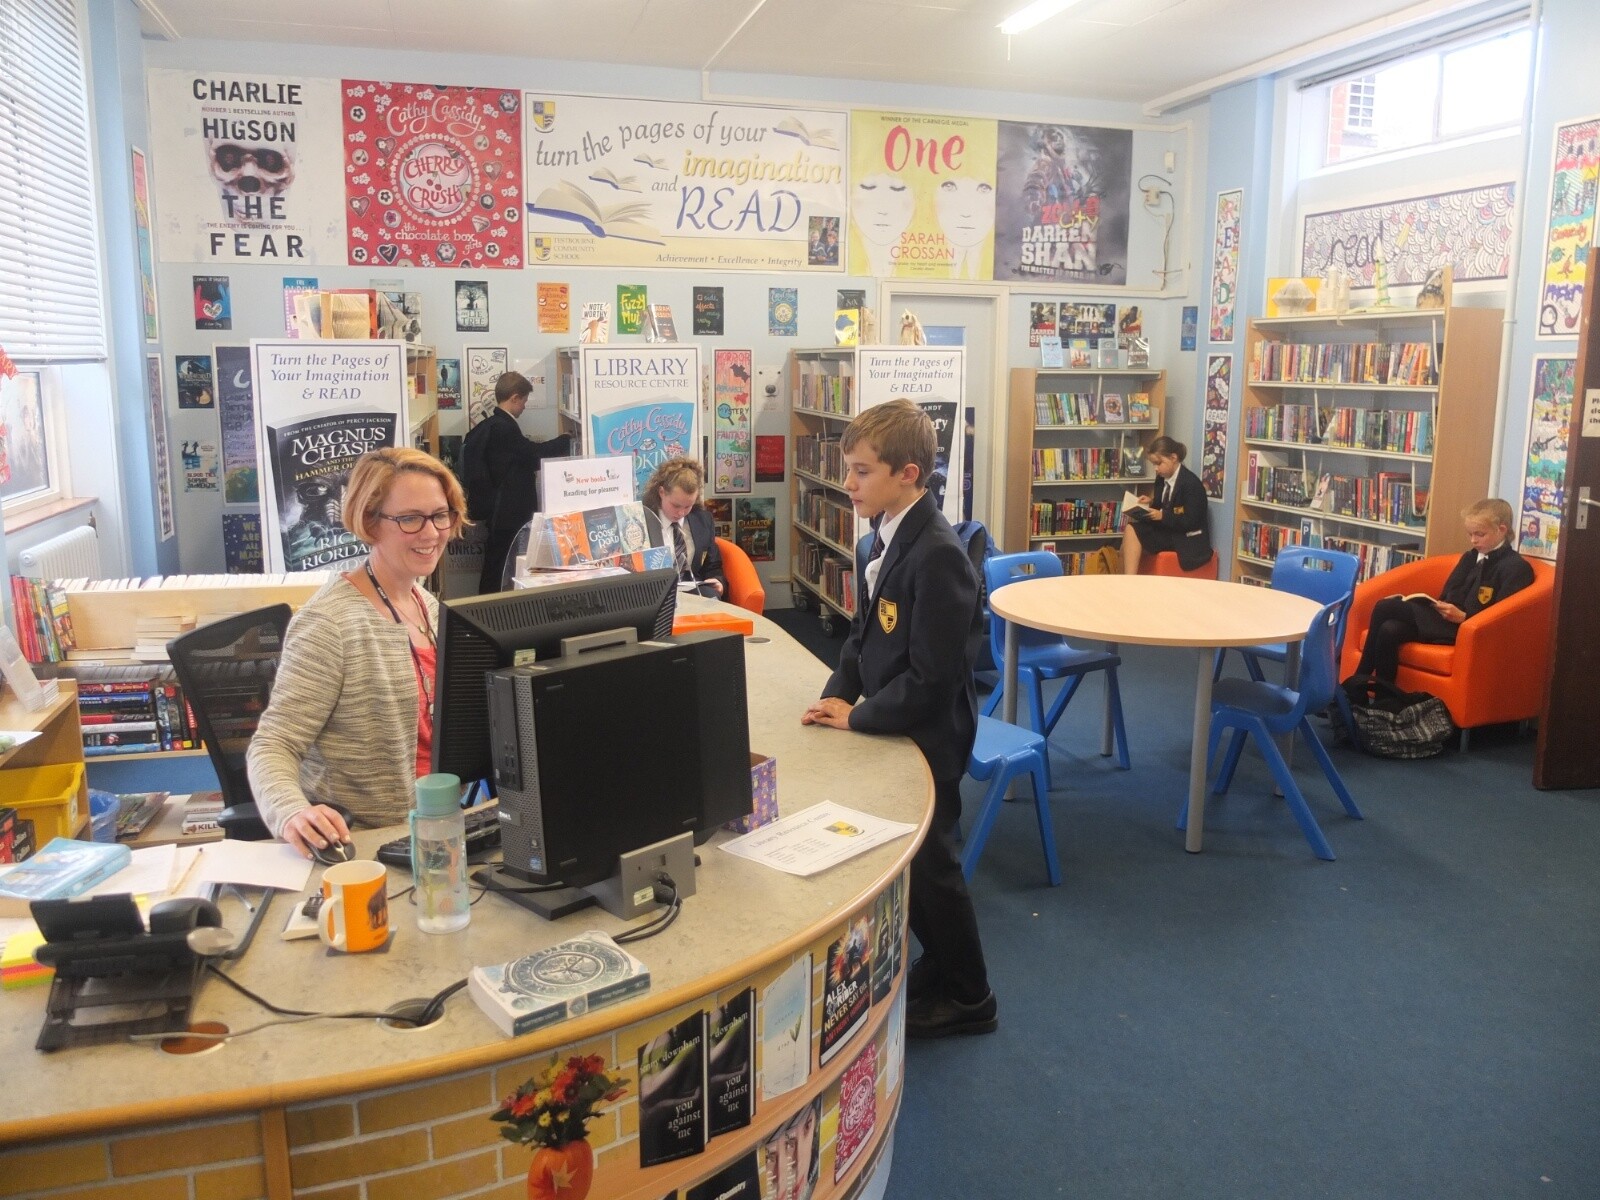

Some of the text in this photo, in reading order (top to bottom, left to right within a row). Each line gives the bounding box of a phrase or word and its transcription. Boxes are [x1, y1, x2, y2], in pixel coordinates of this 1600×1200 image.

[192, 78, 303, 105] CHARLIE
[386, 95, 487, 137] Cathy Cassidy
[922, 118, 951, 126] CARNEGIE
[202, 118, 296, 143] HIGSON
[536, 111, 767, 167] turn the pages of your
[884, 125, 965, 175] One
[405, 153, 466, 178] CHERRY
[681, 149, 843, 186] imagination
[408, 184, 461, 210] CRUSH
[651, 175, 802, 232] and READ
[222, 195, 287, 220] THE
[403, 222, 418, 233] the
[1060, 209, 1099, 231] City
[394, 229, 476, 243] chocolate box
[900, 232, 945, 246] SARAH
[1022, 221, 1098, 243] DARREN
[210, 233, 304, 258] FEAR
[464, 239, 483, 255] girls
[890, 246, 955, 260] CROSSAN
[1321, 220, 1384, 271] read
[655, 254, 803, 268] Achievement Excellence Integrity
[1021, 242, 1097, 271] SHAN
[583, 310, 608, 319] WORTHY
[588, 303, 604, 311] NOTE
[461, 317, 485, 326] TREE
[270, 353, 390, 369] Turn the Pages of
[593, 358, 689, 376] LIBRARY
[869, 356, 955, 369] Turn the Pages of
[270, 369, 390, 384] Your Imagination
[594, 378, 689, 389] RESOURCE CENTRE
[868, 369, 954, 381] Your Imagination
[302, 387, 362, 400] & READ
[890, 383, 933, 393] & READ
[283, 430, 300, 438] FROM
[301, 425, 312, 433] THE
[313, 421, 337, 430] CREATOR
[607, 407, 689, 457] Cathy Cassidy
[716, 431, 749, 440] FANTASY
[291, 427, 386, 457] MAGNUS
[301, 440, 377, 465] CHASE
[716, 453, 749, 461] COMEDY
[294, 464, 342, 482] HAMMER
[576, 475, 607, 485] New books
[563, 485, 620, 498] Reading for pleasure
[589, 529, 615, 542] GOOSE
[1303, 526, 1310, 536] P
[598, 535, 620, 549] ROAD
[826, 980, 847, 1006] ALEX
[837, 980, 858, 1007] RIDER
[824, 1003, 849, 1033] NEVER
[848, 991, 859, 1007] SAY
[715, 1011, 748, 1039] downham
[662, 1035, 701, 1063] downham
[726, 1074, 742, 1092] you
[719, 1084, 749, 1106] against
[675, 1099, 694, 1117] you
[727, 1101, 740, 1112] me
[667, 1111, 701, 1132] against
[677, 1128, 692, 1139] me
